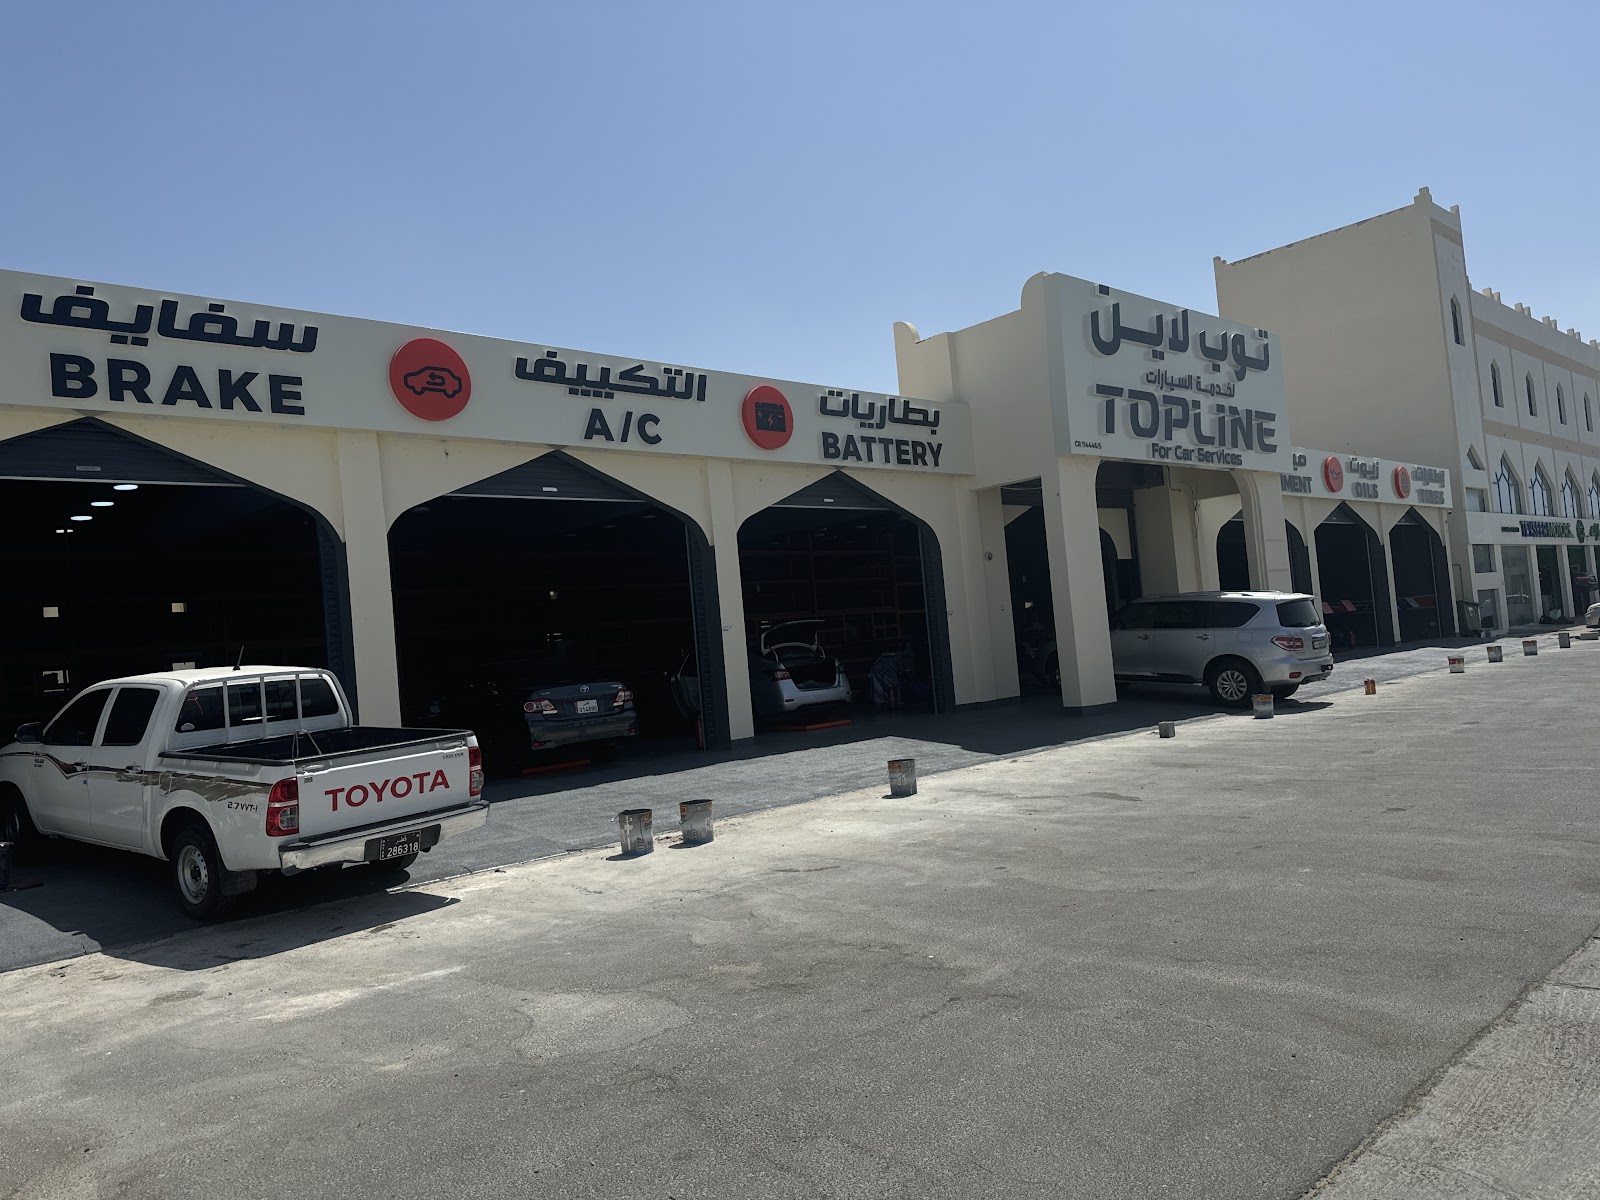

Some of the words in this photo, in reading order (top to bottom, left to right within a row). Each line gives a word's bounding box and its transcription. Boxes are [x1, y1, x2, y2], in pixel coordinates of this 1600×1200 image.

[20, 285, 319, 353] سفايف
[1199, 329, 1270, 382] توب
[49, 352, 305, 415] BRAKE
[514, 350, 707, 402] التكييف
[1146, 369, 1193, 392] السيارات
[583, 408, 663, 445] A/C
[819, 390, 941, 435] بطاريات
[1096, 384, 1278, 453] TOPLINE
[821, 431, 943, 467] BATTERY
[1151, 442, 1172, 459] For
[1174, 445, 1195, 461] Car
[1197, 447, 1243, 466] Services
[1349, 457, 1380, 480] زيوت
[1354, 481, 1379, 499] OILS
[324, 769, 450, 812] TOYOTA
[386, 841, 419, 857] 286318
